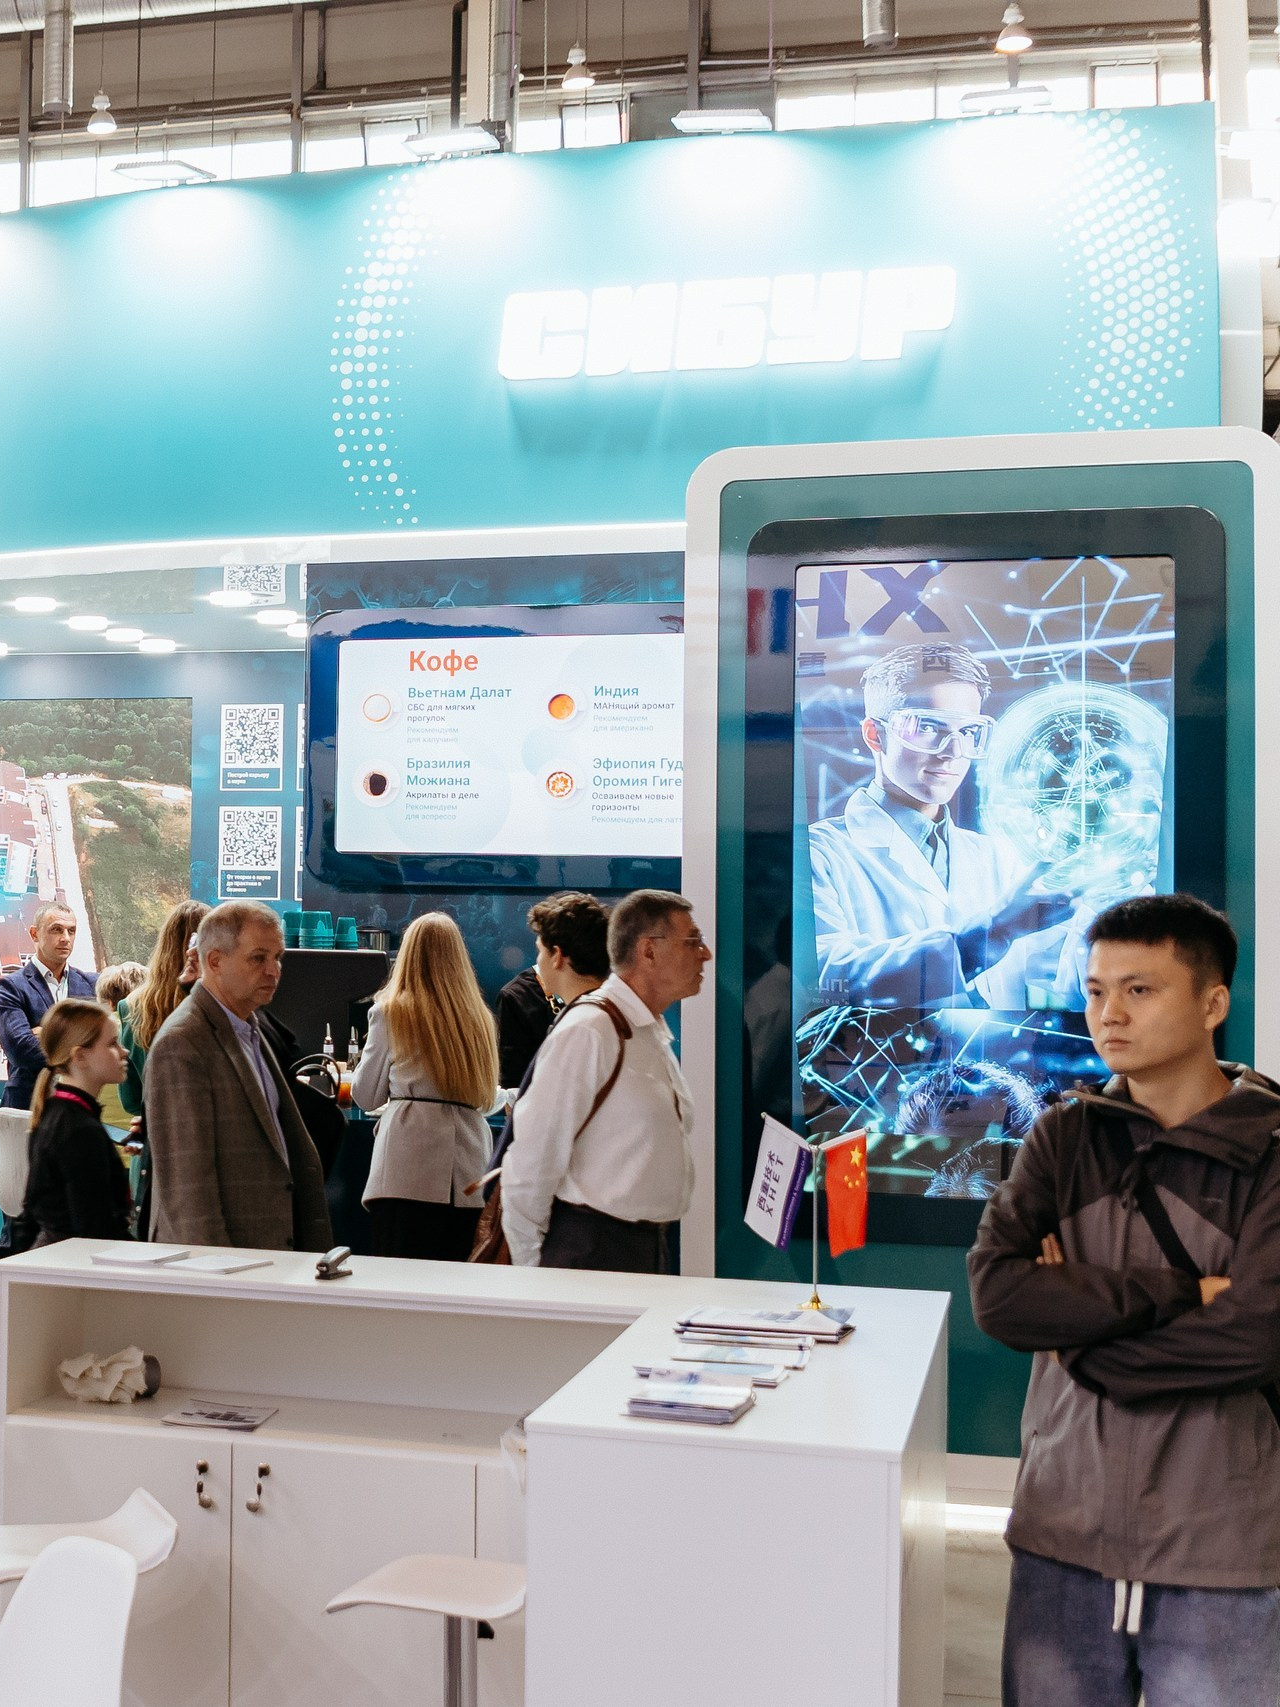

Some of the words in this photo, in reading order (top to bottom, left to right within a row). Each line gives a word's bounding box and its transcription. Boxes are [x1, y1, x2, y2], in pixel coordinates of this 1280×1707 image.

[498, 265, 956, 380] СИБУР
[409, 649, 478, 676] Кофе
[408, 688, 466, 698] Вьетнам
[470, 686, 512, 700] Далат
[594, 686, 638, 698] Индия
[426, 704, 442, 712] для
[594, 702, 639, 710] МАНящий
[408, 715, 445, 723] прогулок
[407, 758, 470, 771] Бразилия
[593, 758, 655, 771] Эфиопия
[407, 775, 470, 785] Можиана
[592, 776, 647, 788] Оромия
[653, 776, 682, 786] Гиге
[592, 792, 642, 800] Осваиваем
[592, 804, 640, 812] горизонты
[756, 1150, 776, 1212] 西重技术
[765, 1156, 784, 1218] XHET
